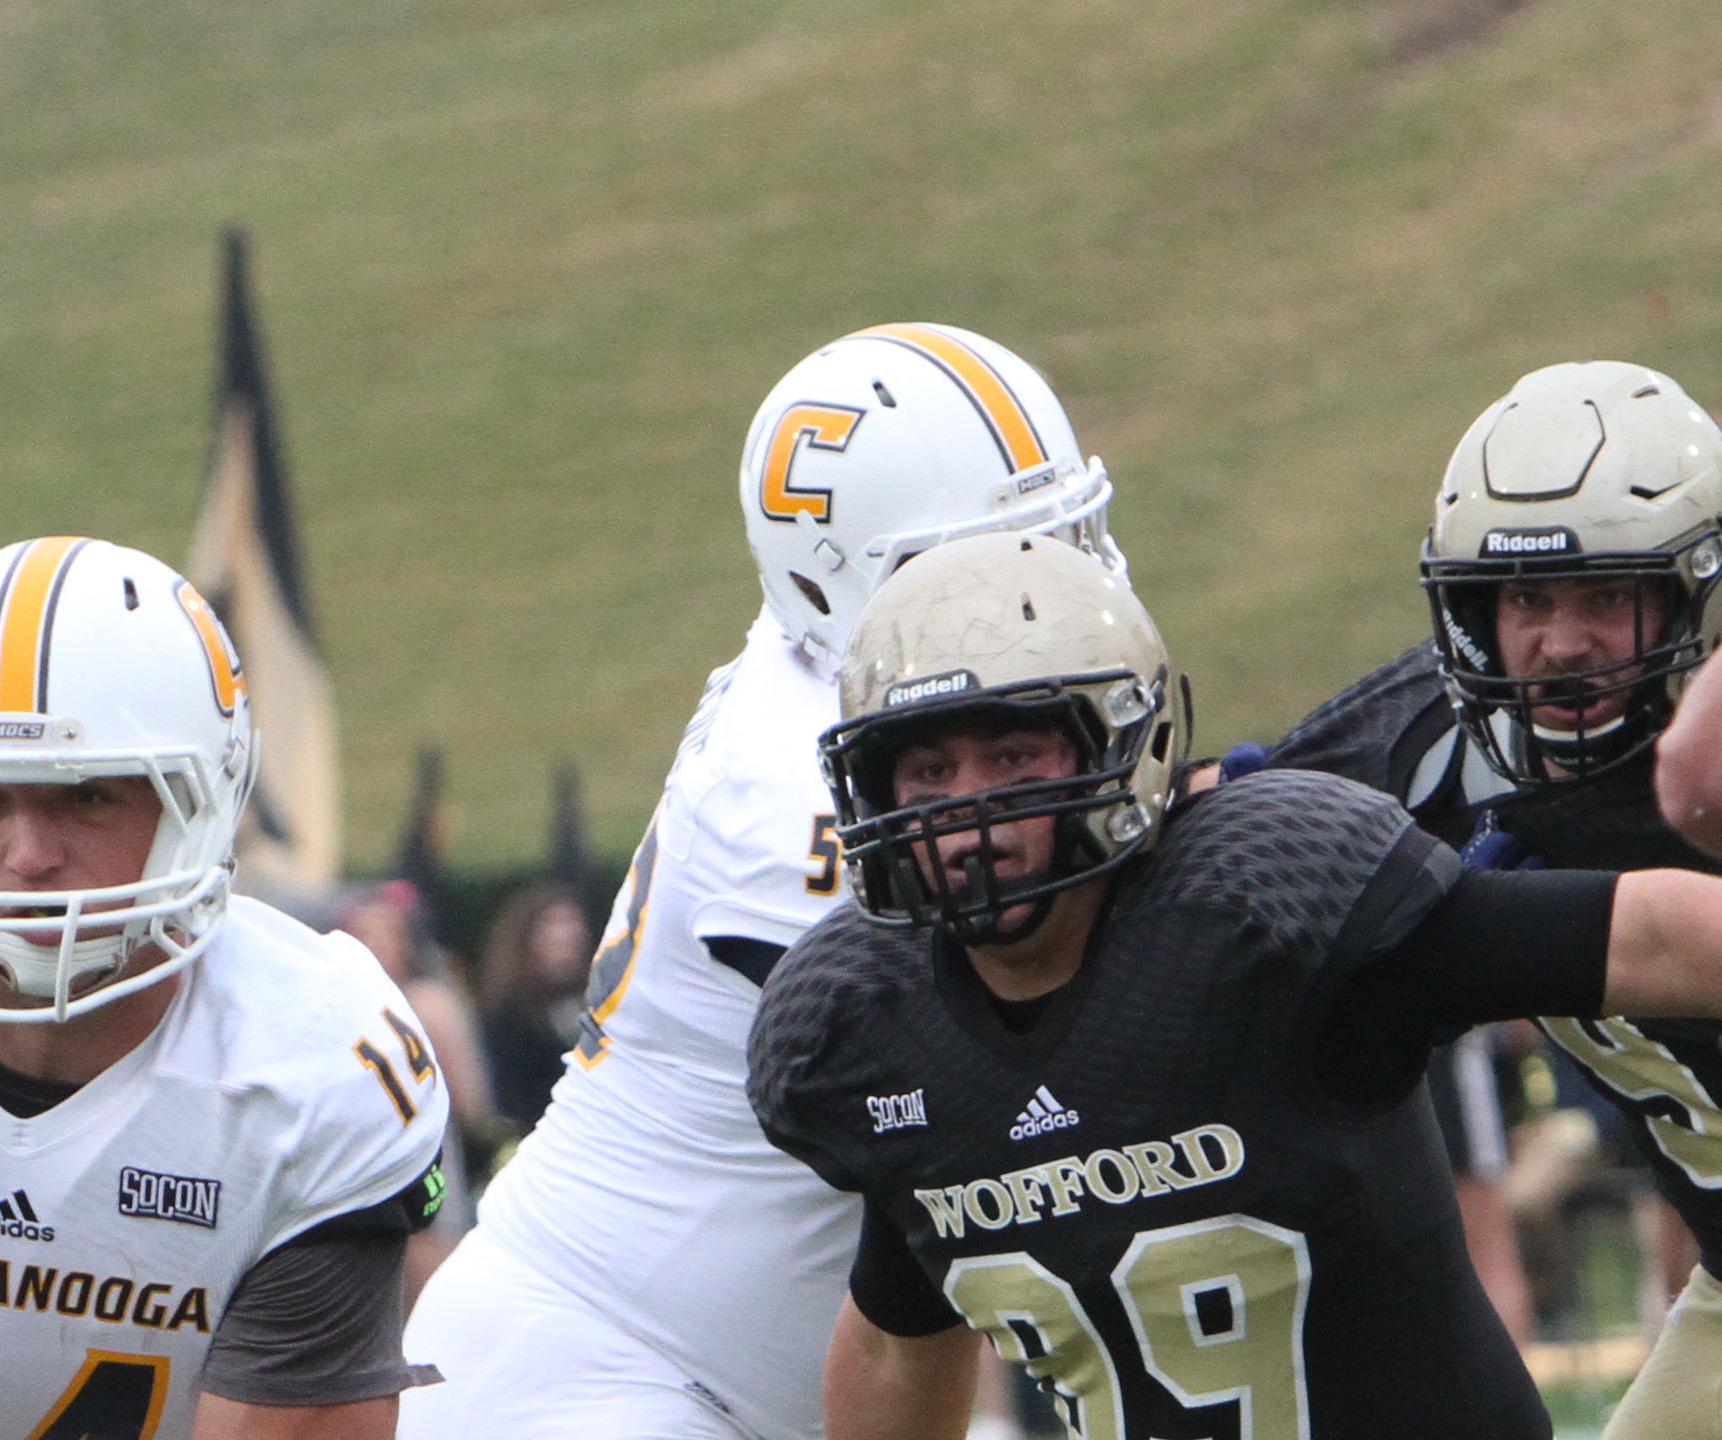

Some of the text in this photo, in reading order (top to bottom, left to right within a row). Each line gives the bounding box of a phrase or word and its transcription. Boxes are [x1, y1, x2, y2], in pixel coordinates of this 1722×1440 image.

[759, 401, 867, 523] C
[888, 672, 969, 706] Riddell
[352, 1004, 438, 1128] 14
[914, 1123, 1245, 1240] WOFFORD
[1009, 1109, 1080, 1141] adidas
